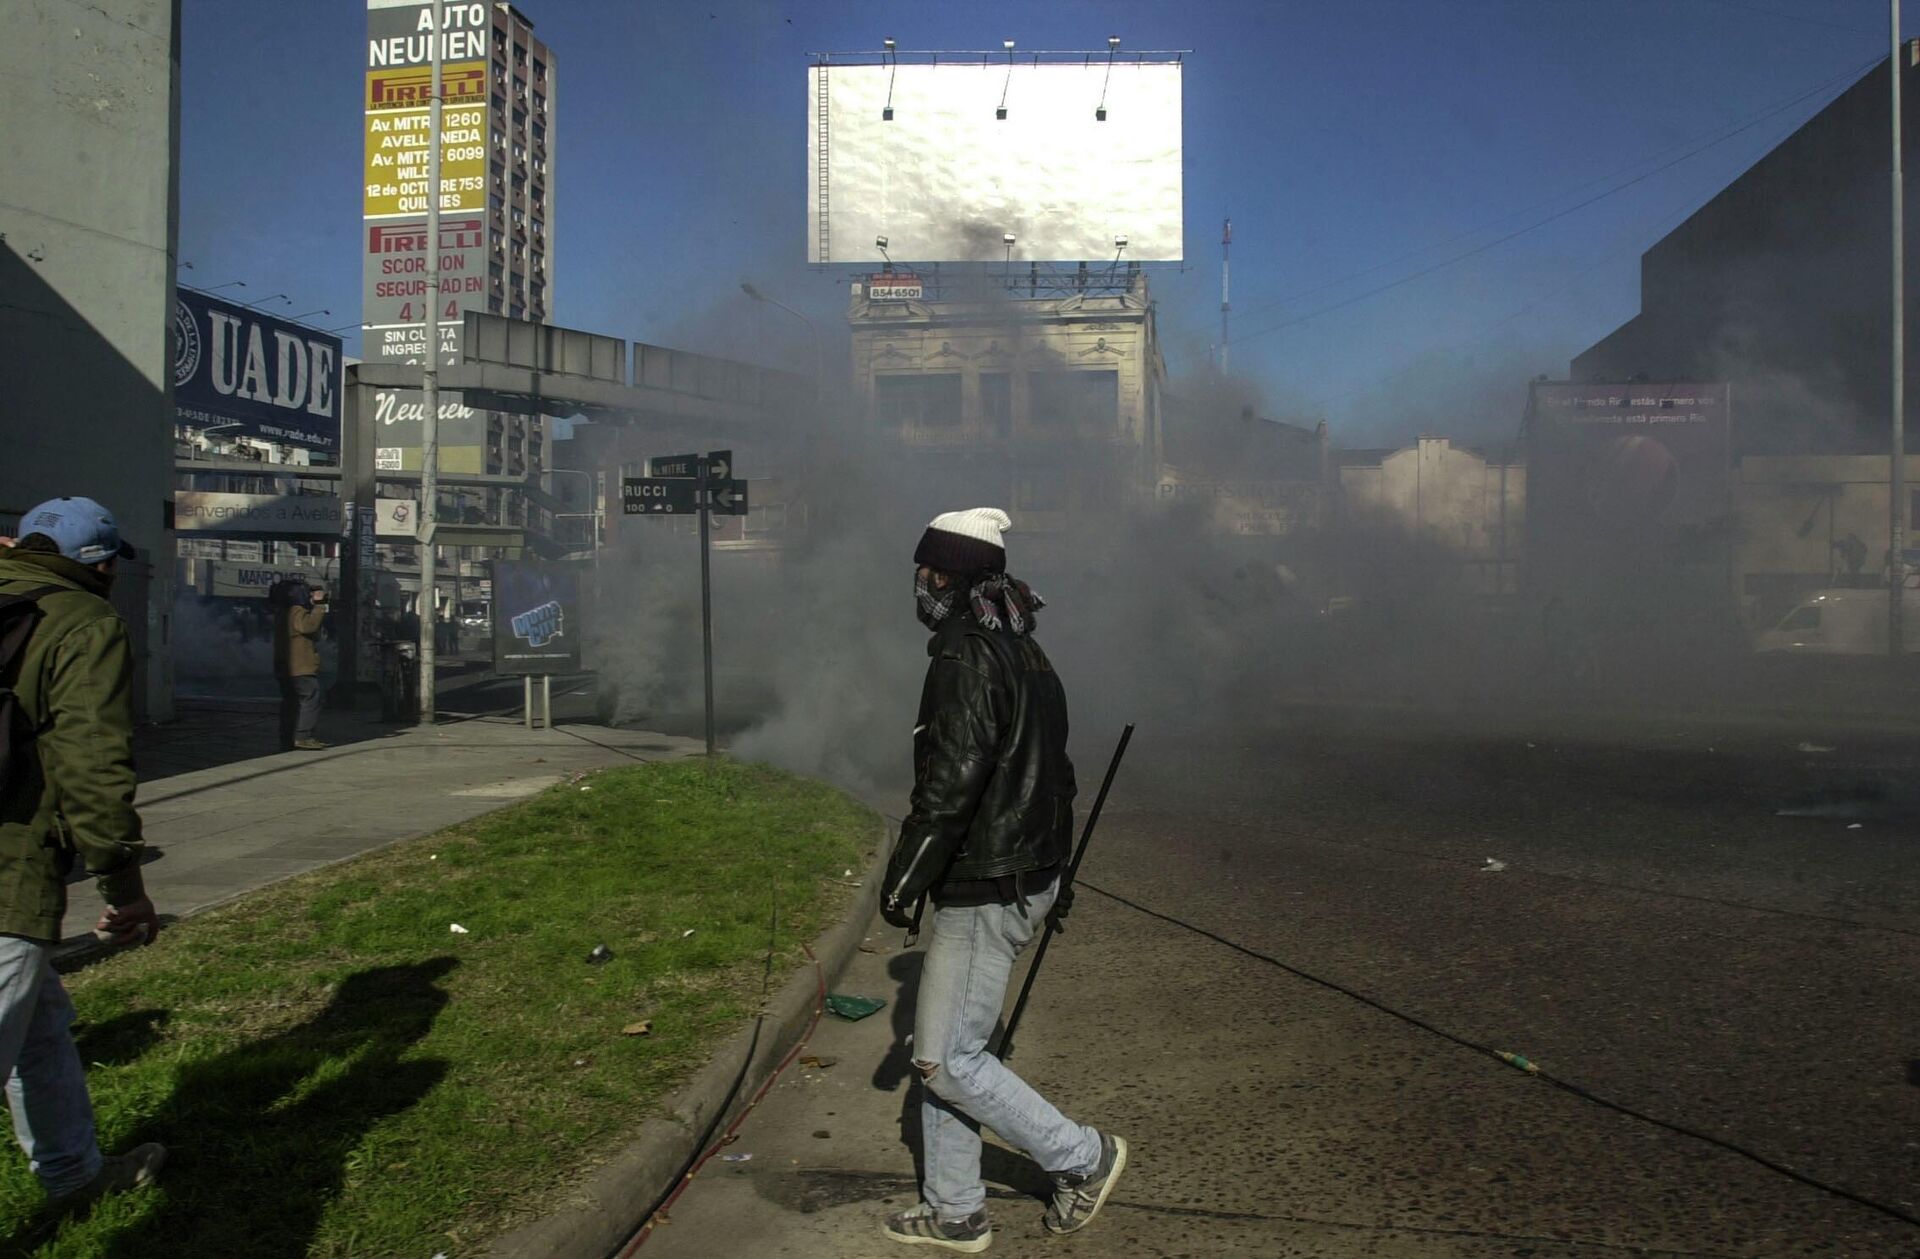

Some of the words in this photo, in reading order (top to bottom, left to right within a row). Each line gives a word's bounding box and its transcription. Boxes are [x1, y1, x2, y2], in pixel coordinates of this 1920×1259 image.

[393, 115, 431, 131] MITR
[445, 112, 481, 127] 1260
[381, 129, 481, 148] AVELLNEDA
[397, 150, 443, 165] MITR
[447, 146, 484, 161] 6099
[397, 166, 430, 180] WILD
[366, 184, 381, 197] 12
[382, 184, 398, 196] de
[400, 178, 457, 195] OCTRE
[459, 176, 484, 191] 753
[398, 194, 461, 212] QUILES
[382, 254, 465, 274] SCORION
[376, 278, 461, 298] SEGURAD
[465, 276, 483, 292] EN
[385, 331, 406, 343] SIN
[409, 328, 456, 341] CUTA
[382, 343, 427, 356] INGRES
[208, 309, 333, 418] UADE
[375, 392, 475, 425] Neuen
[625, 485, 667, 497] RUCCI
[178, 504, 272, 520] envenidos
[291, 504, 342, 521] Avella
